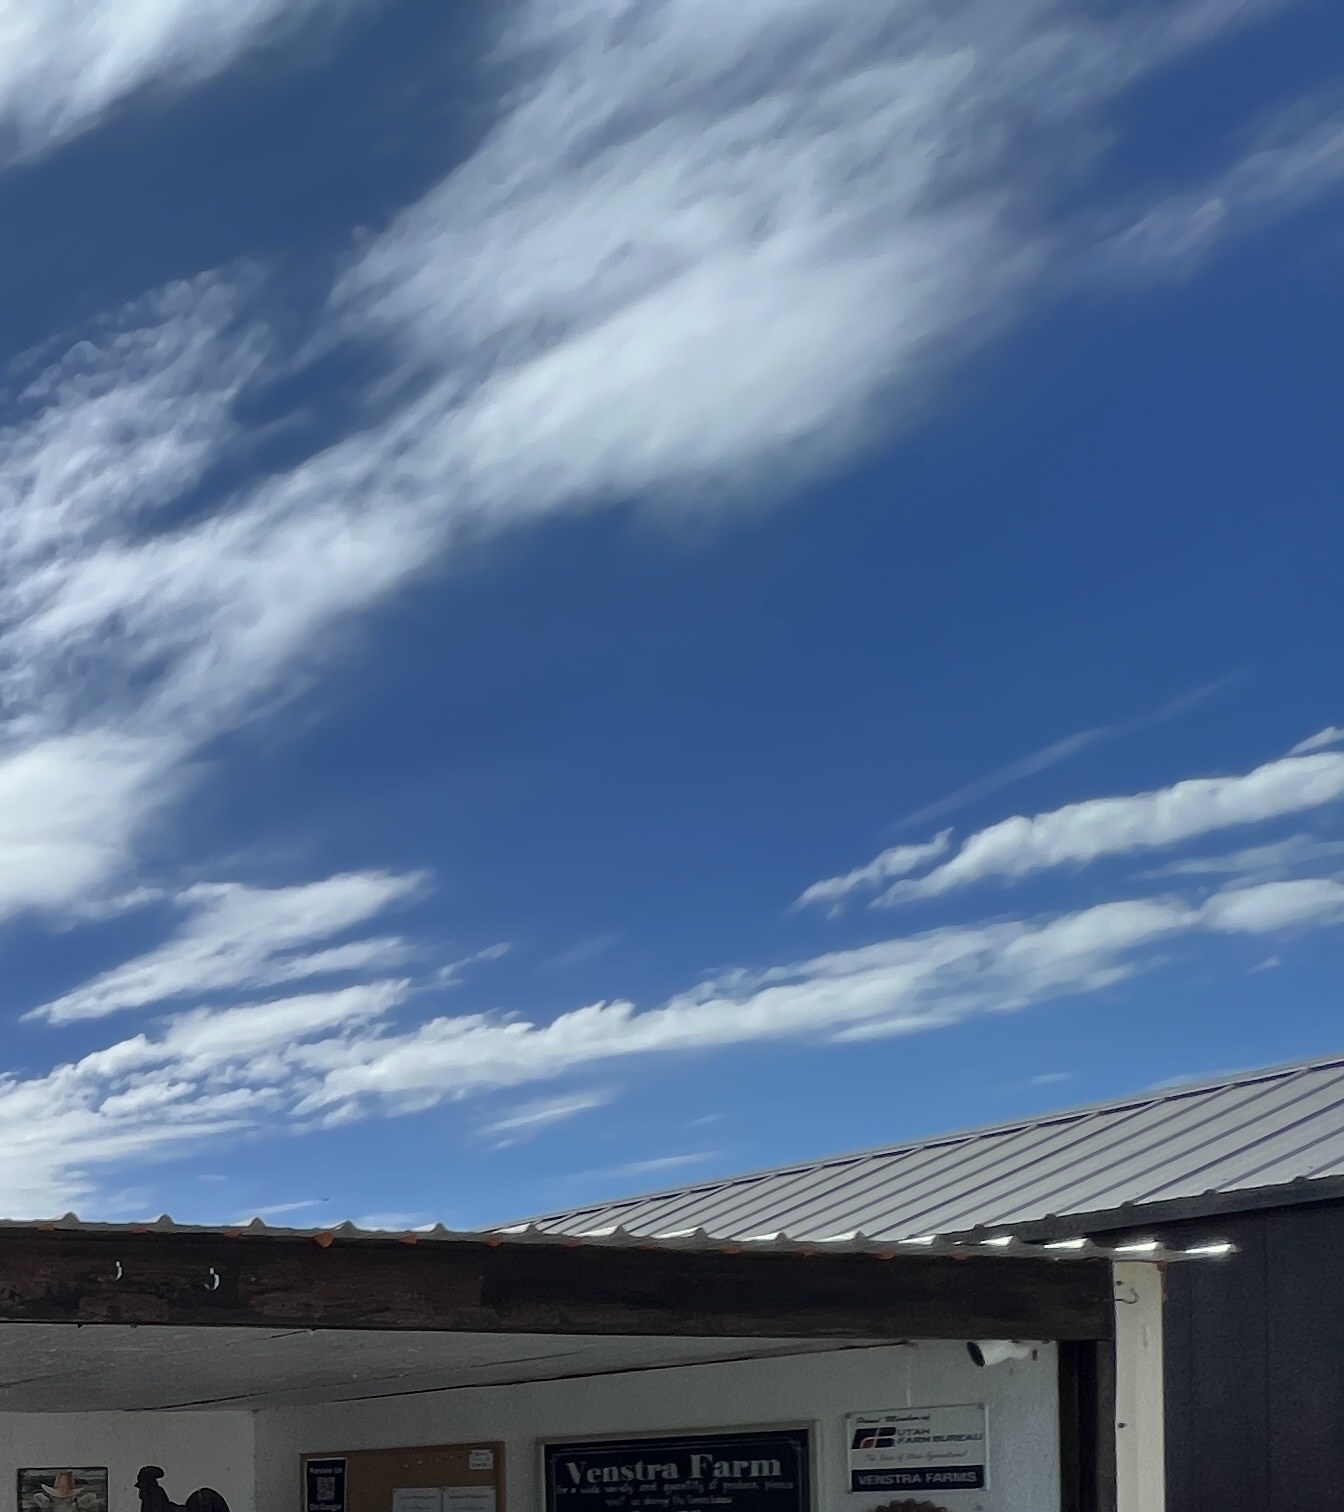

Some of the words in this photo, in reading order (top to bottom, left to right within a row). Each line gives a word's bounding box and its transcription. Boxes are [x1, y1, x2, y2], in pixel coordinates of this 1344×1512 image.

[897, 1428, 930, 1437] UTAH
[933, 1433, 983, 1443] BUREAU
[566, 1459, 680, 1485] Venstra
[690, 1453, 783, 1479] Farm
[858, 1473, 922, 1486] VENSTRA
[924, 1471, 978, 1483] FARMS
